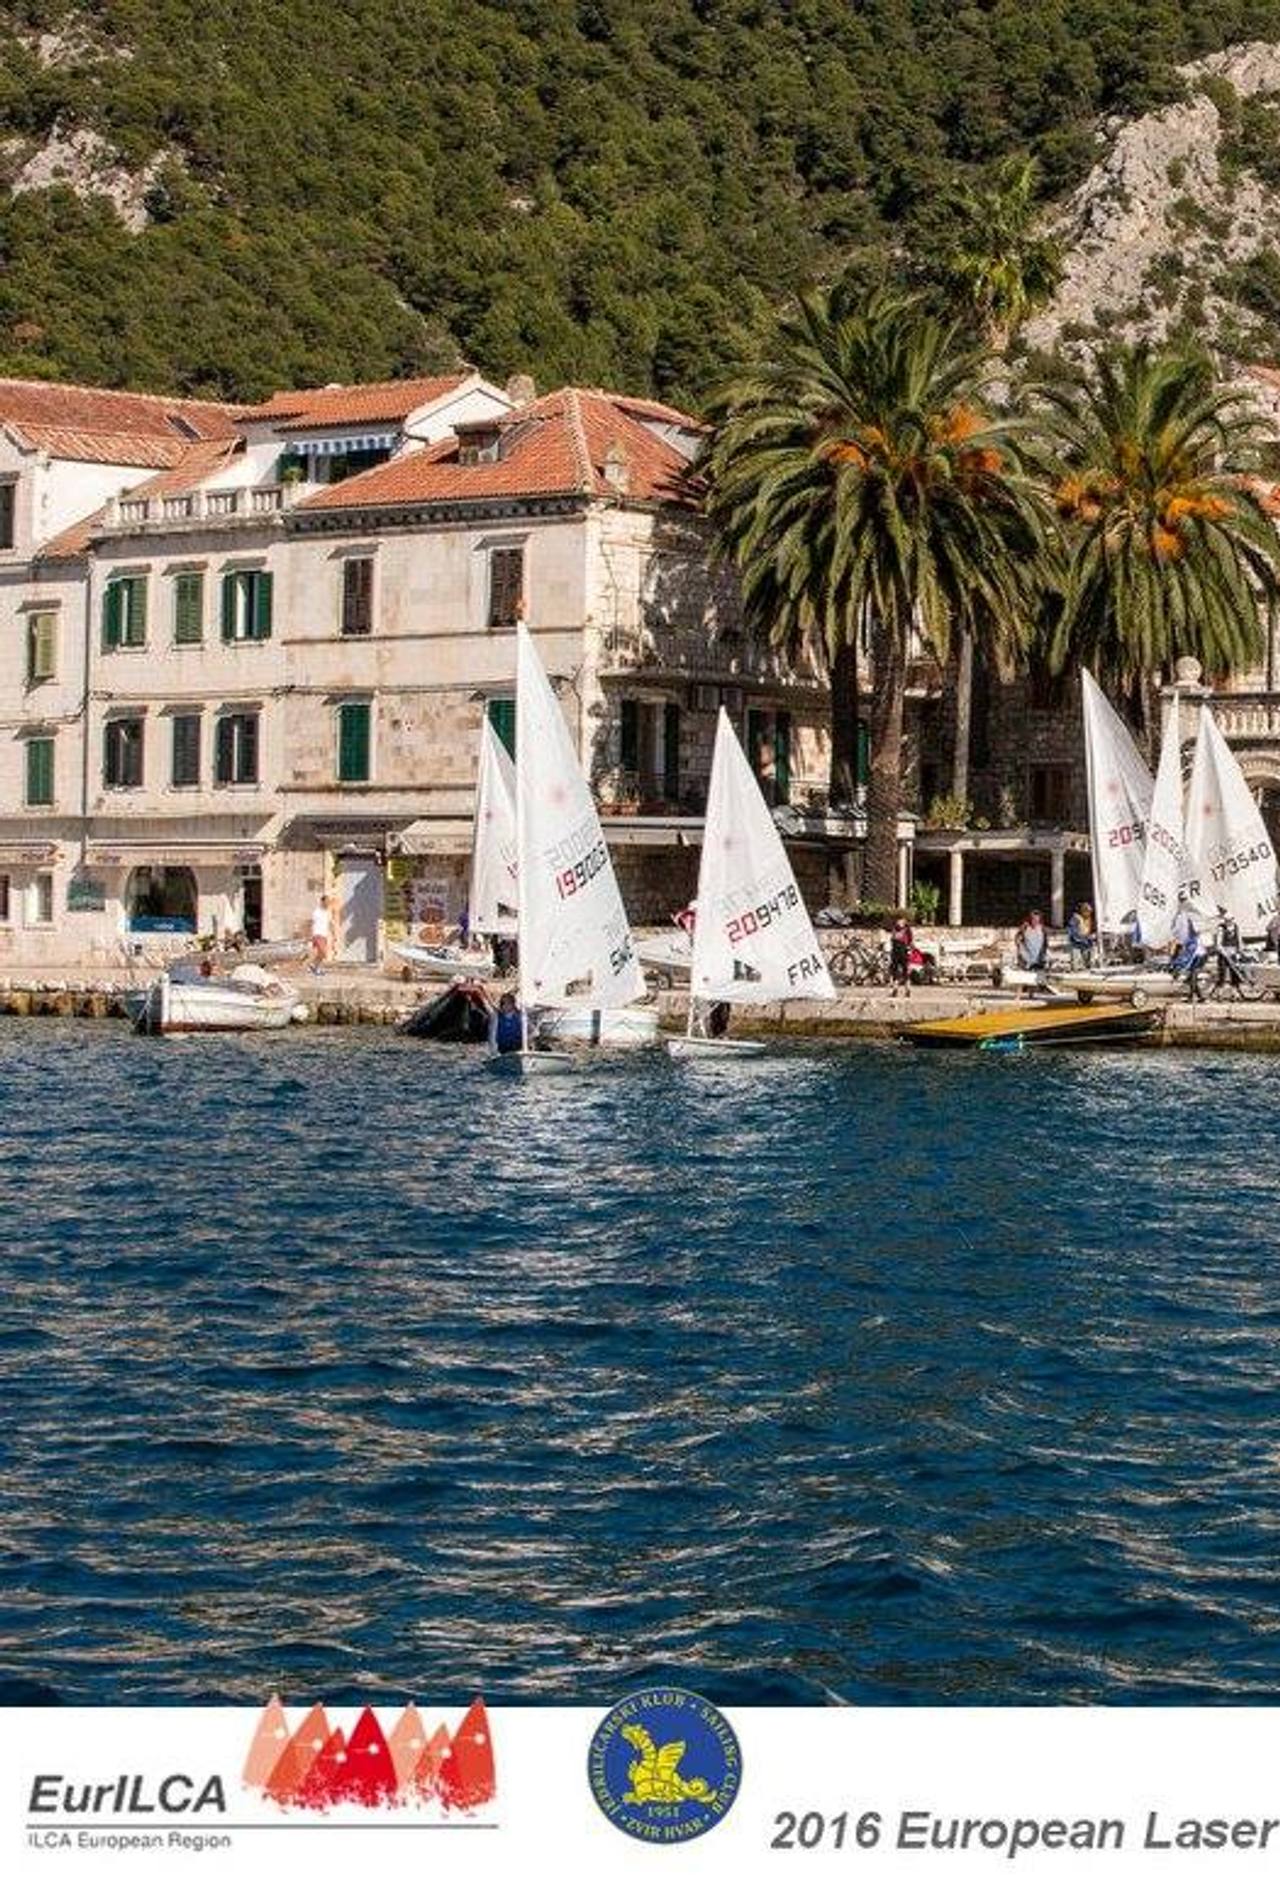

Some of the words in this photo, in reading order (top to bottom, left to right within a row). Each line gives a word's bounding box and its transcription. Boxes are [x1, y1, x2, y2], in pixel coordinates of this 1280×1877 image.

[1210, 841, 1272, 882] 173540
[726, 884, 799, 943] 209478
[787, 954, 823, 986] FRA
